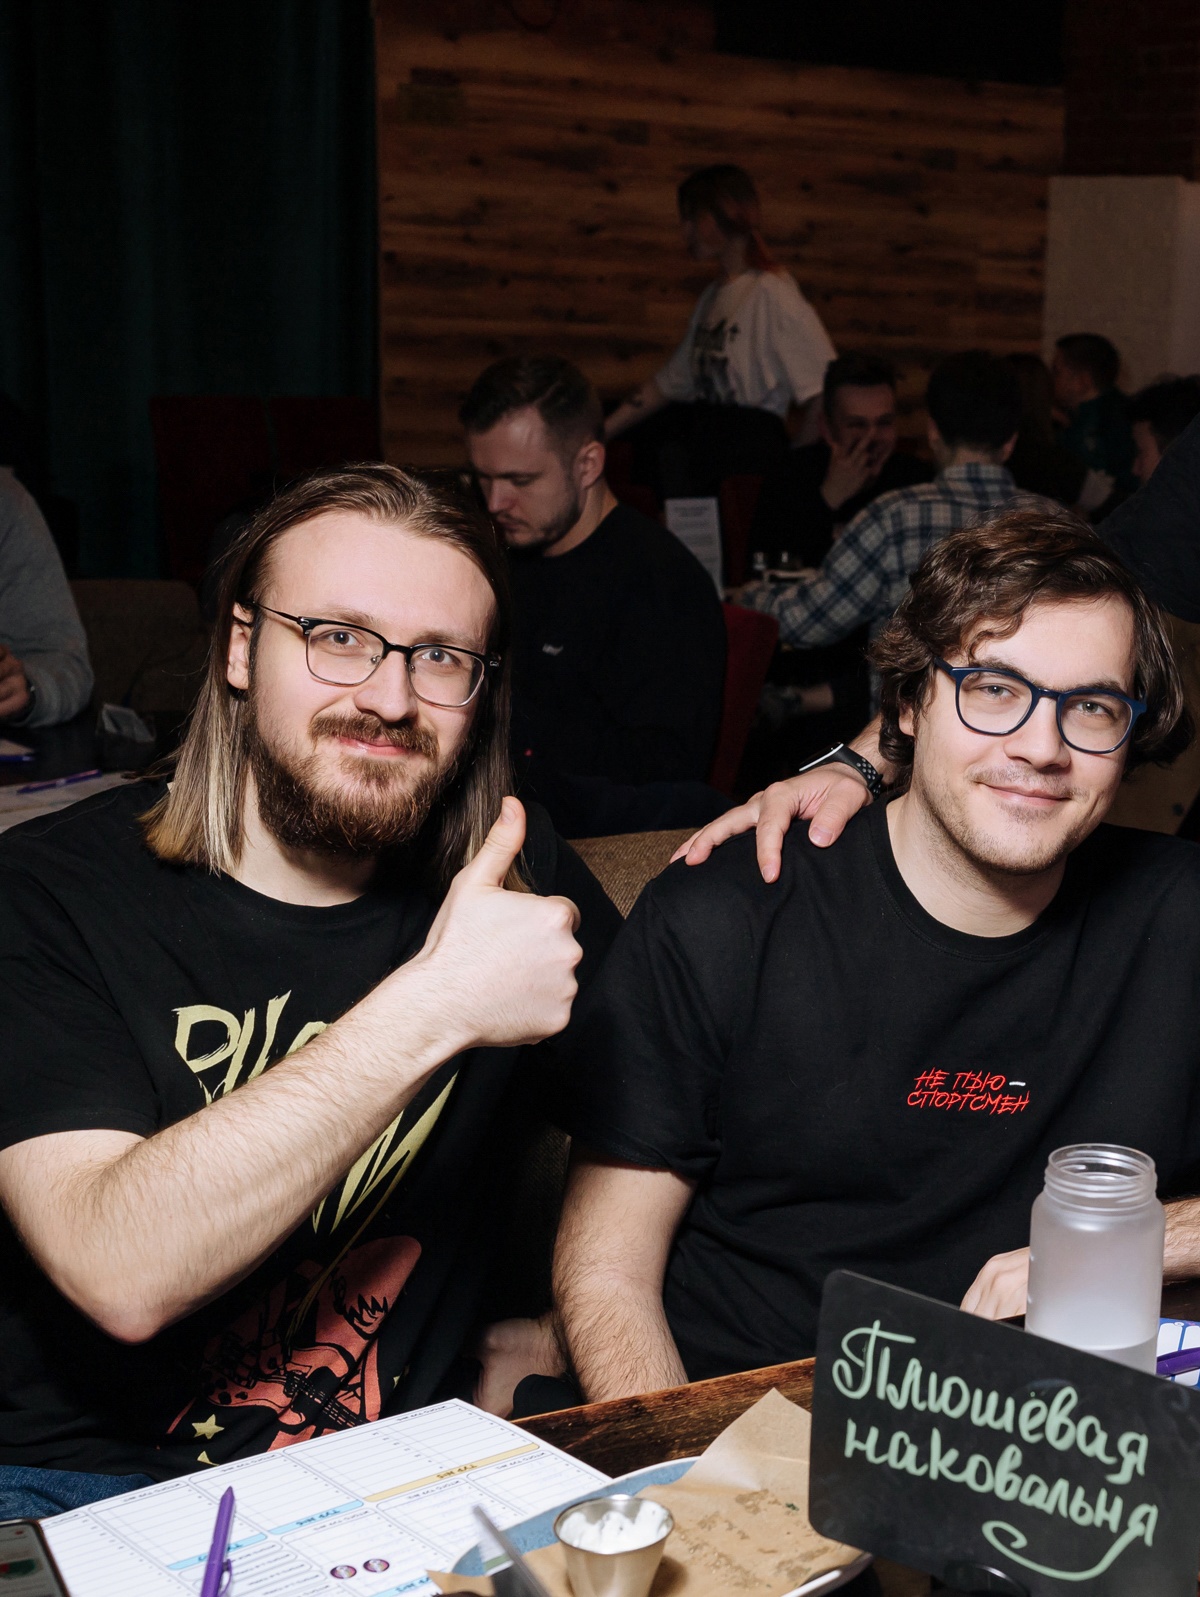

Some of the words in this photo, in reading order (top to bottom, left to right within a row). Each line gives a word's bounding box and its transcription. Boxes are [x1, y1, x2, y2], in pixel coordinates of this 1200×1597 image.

[914, 1067, 949, 1090] НЕ
[952, 1070, 1005, 1093] ПЬЮ
[907, 1087, 1030, 1115] СПОРТСМЕН
[845, 1418, 1158, 1581] наковальня
